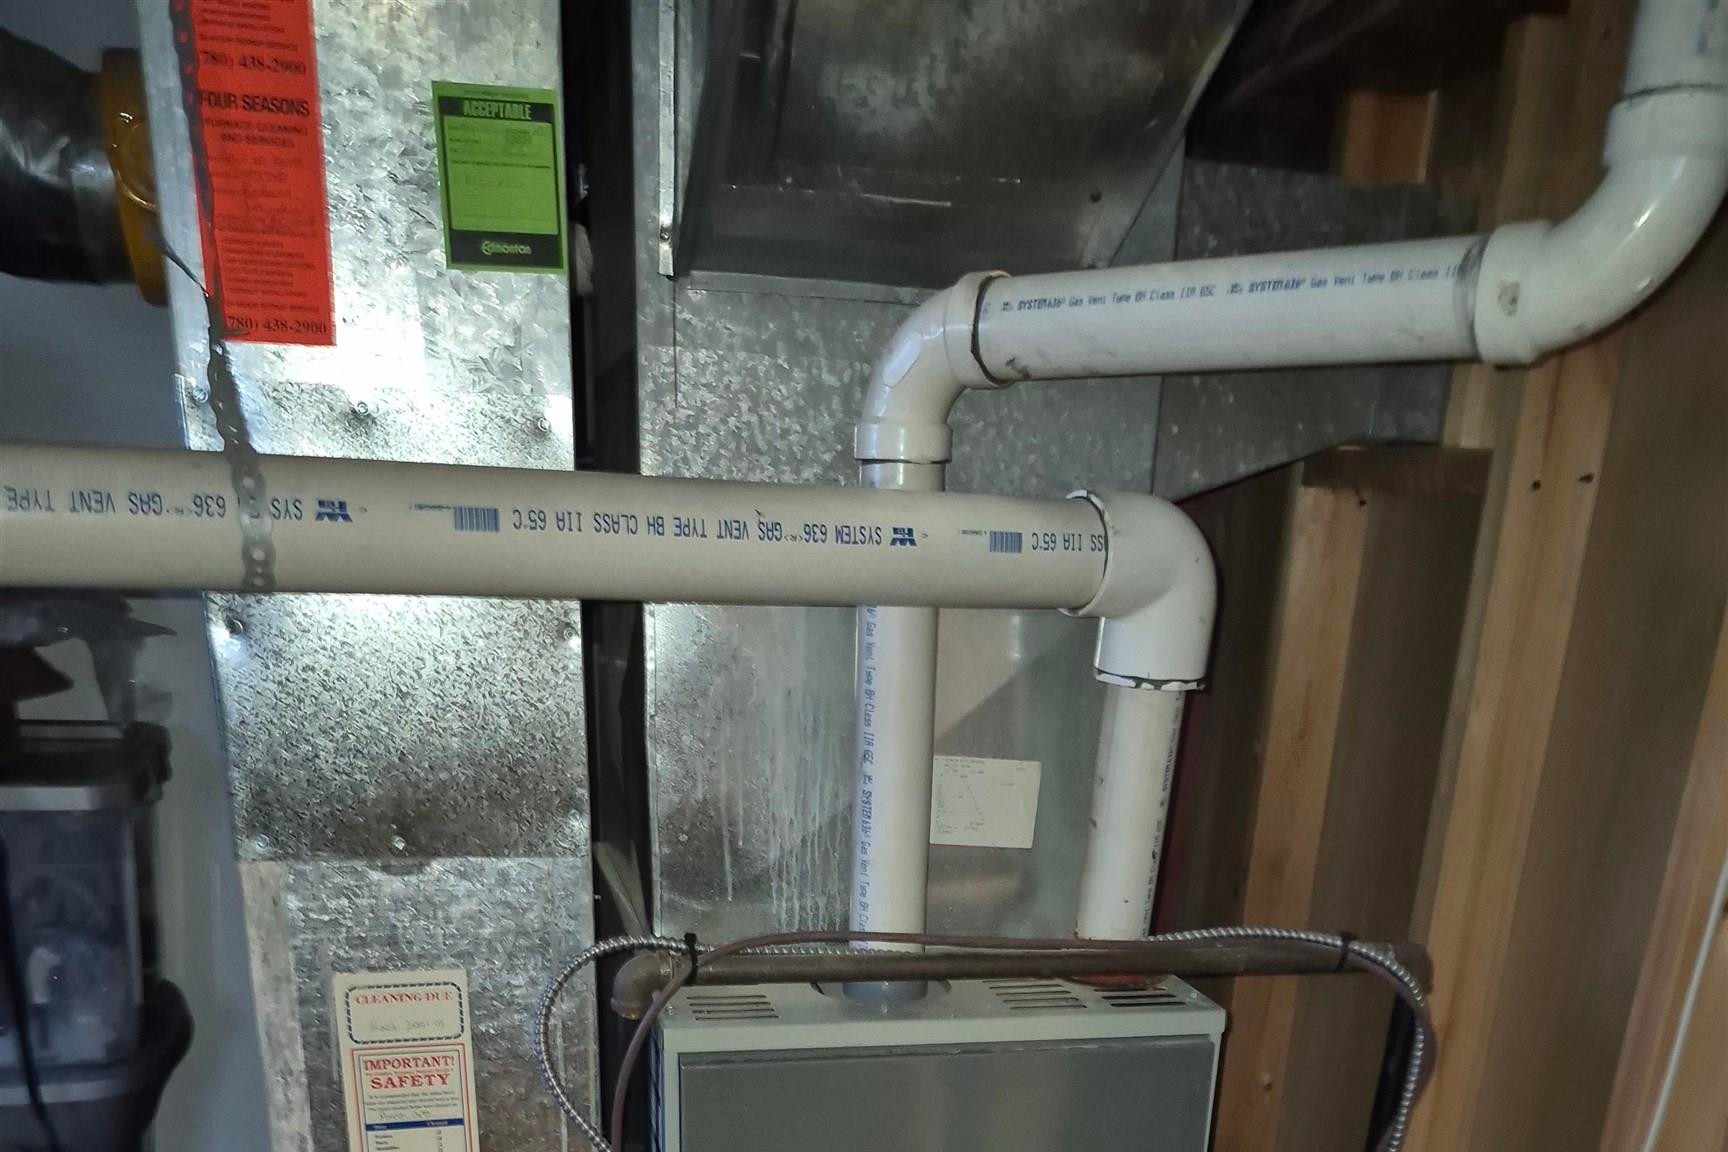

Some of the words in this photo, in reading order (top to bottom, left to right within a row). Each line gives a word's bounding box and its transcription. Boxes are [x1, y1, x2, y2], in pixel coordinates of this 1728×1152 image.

[242, 95, 310, 117] SEASONS
[463, 100, 532, 120] ACCEPTABLE
[480, 240, 532, 256] Edmonton
[264, 318, 327, 336] 438-2900
[3, 485, 56, 513] TYPE
[69, 488, 116, 514] VENT
[128, 491, 164, 517] GAS
[556, 511, 583, 534] IIA
[593, 513, 638, 535] CLASS
[647, 515, 665, 537] BH
[673, 516, 708, 539] TYPE
[716, 519, 750, 541] VENT
[834, 525, 882, 546] SYSTEM
[1062, 532, 1083, 552] IIA
[355, 992, 422, 1005] CLEANING
[425, 991, 453, 1001] DUE
[363, 1055, 455, 1071] IMPORTANT!
[370, 1073, 450, 1090] SAFETY
